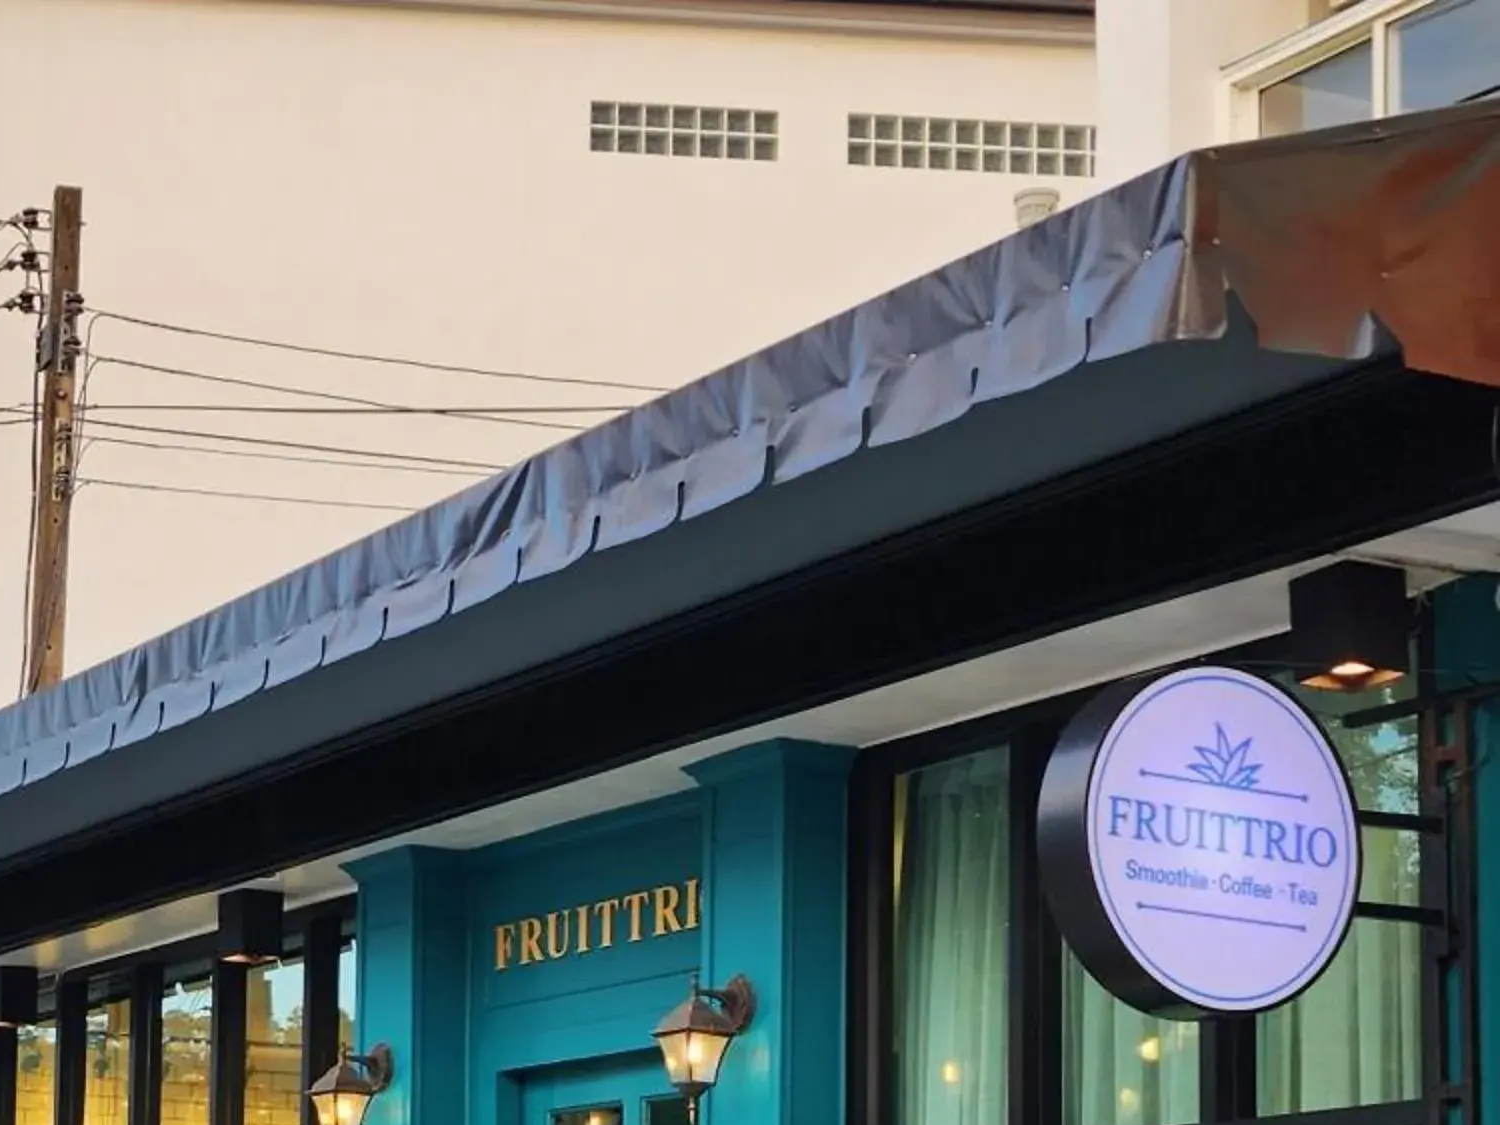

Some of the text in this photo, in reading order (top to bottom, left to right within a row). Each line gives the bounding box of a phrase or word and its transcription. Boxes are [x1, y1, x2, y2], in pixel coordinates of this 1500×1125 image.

[1107, 795, 1338, 868] FRUITTRIO
[1125, 858, 1319, 906] Smoothie Coffee Tea
[494, 878, 703, 971] FRUITTRI
